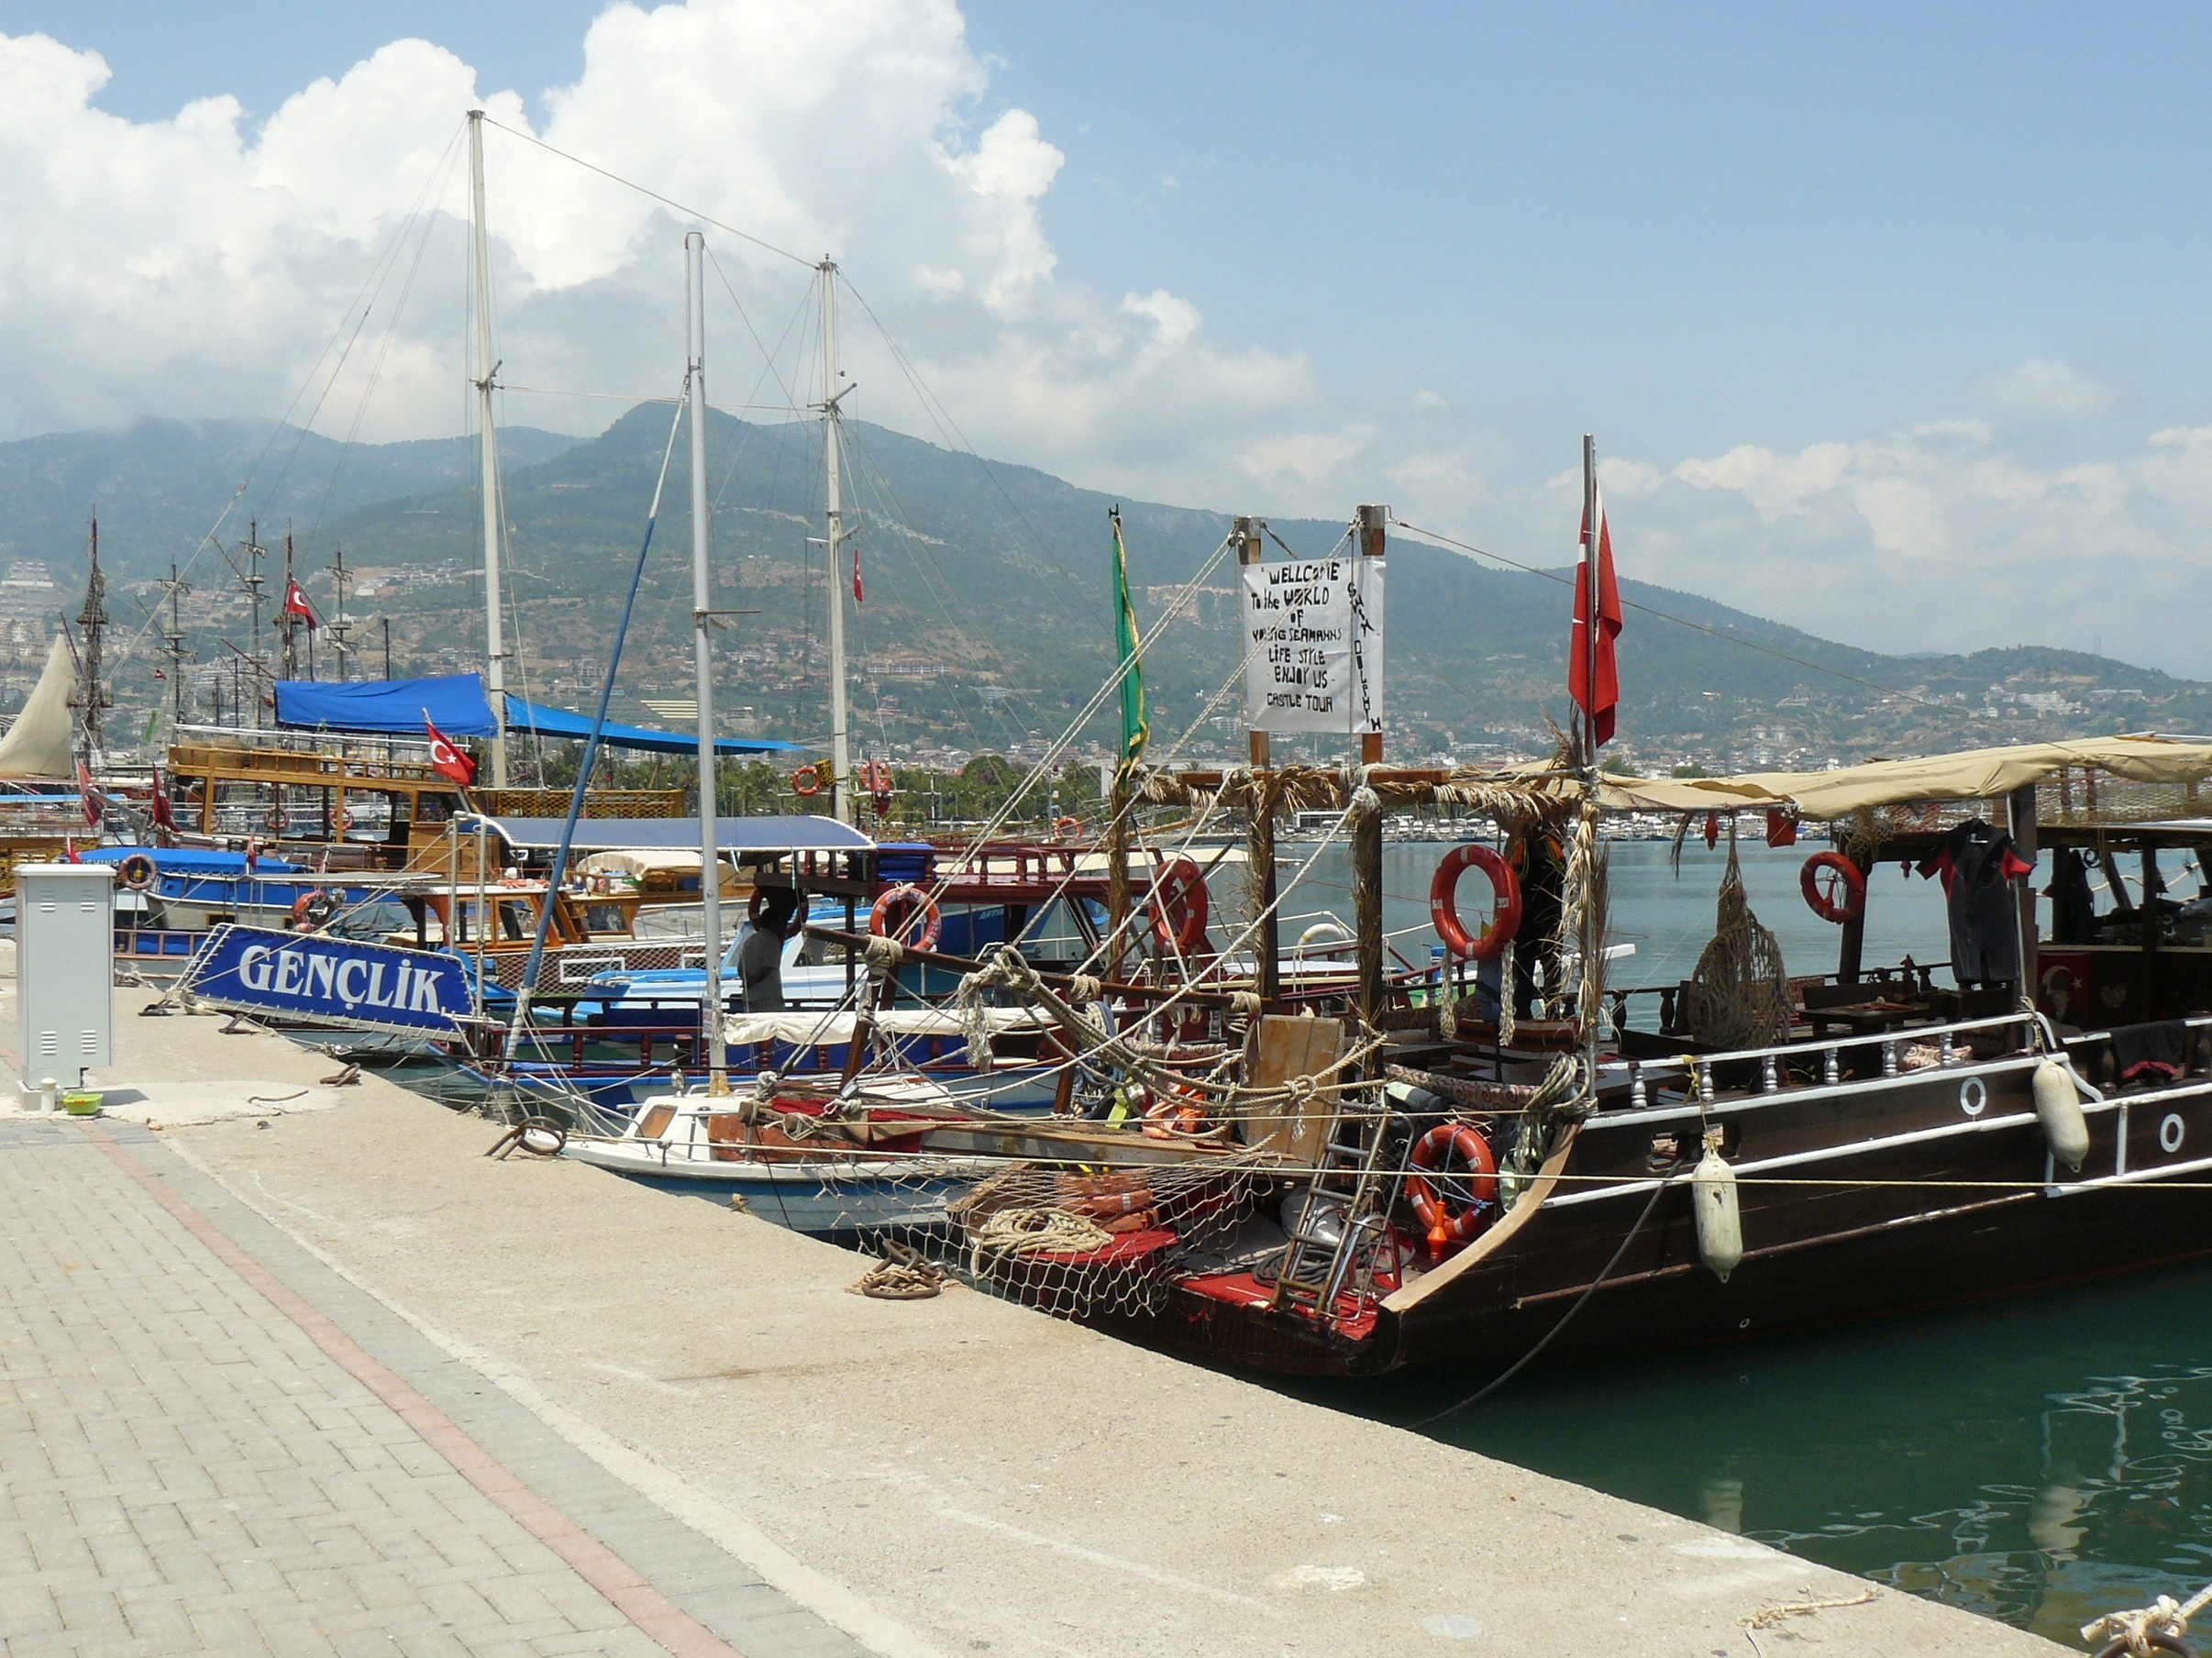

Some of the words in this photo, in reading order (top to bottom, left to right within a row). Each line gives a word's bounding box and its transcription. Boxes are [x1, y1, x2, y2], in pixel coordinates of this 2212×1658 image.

[1269, 562, 1340, 584] WELLCOME
[1251, 592, 1261, 610] To
[1264, 588, 1280, 610] the
[1284, 588, 1330, 607] WORLD
[1299, 647, 1326, 666] STYLE
[1274, 666, 1310, 685] ENJOY
[1313, 670, 1328, 689] US
[1267, 692, 1302, 708] CASTLE
[1305, 694, 1333, 713] TOUR
[238, 945, 445, 1014] GENÇLİK
